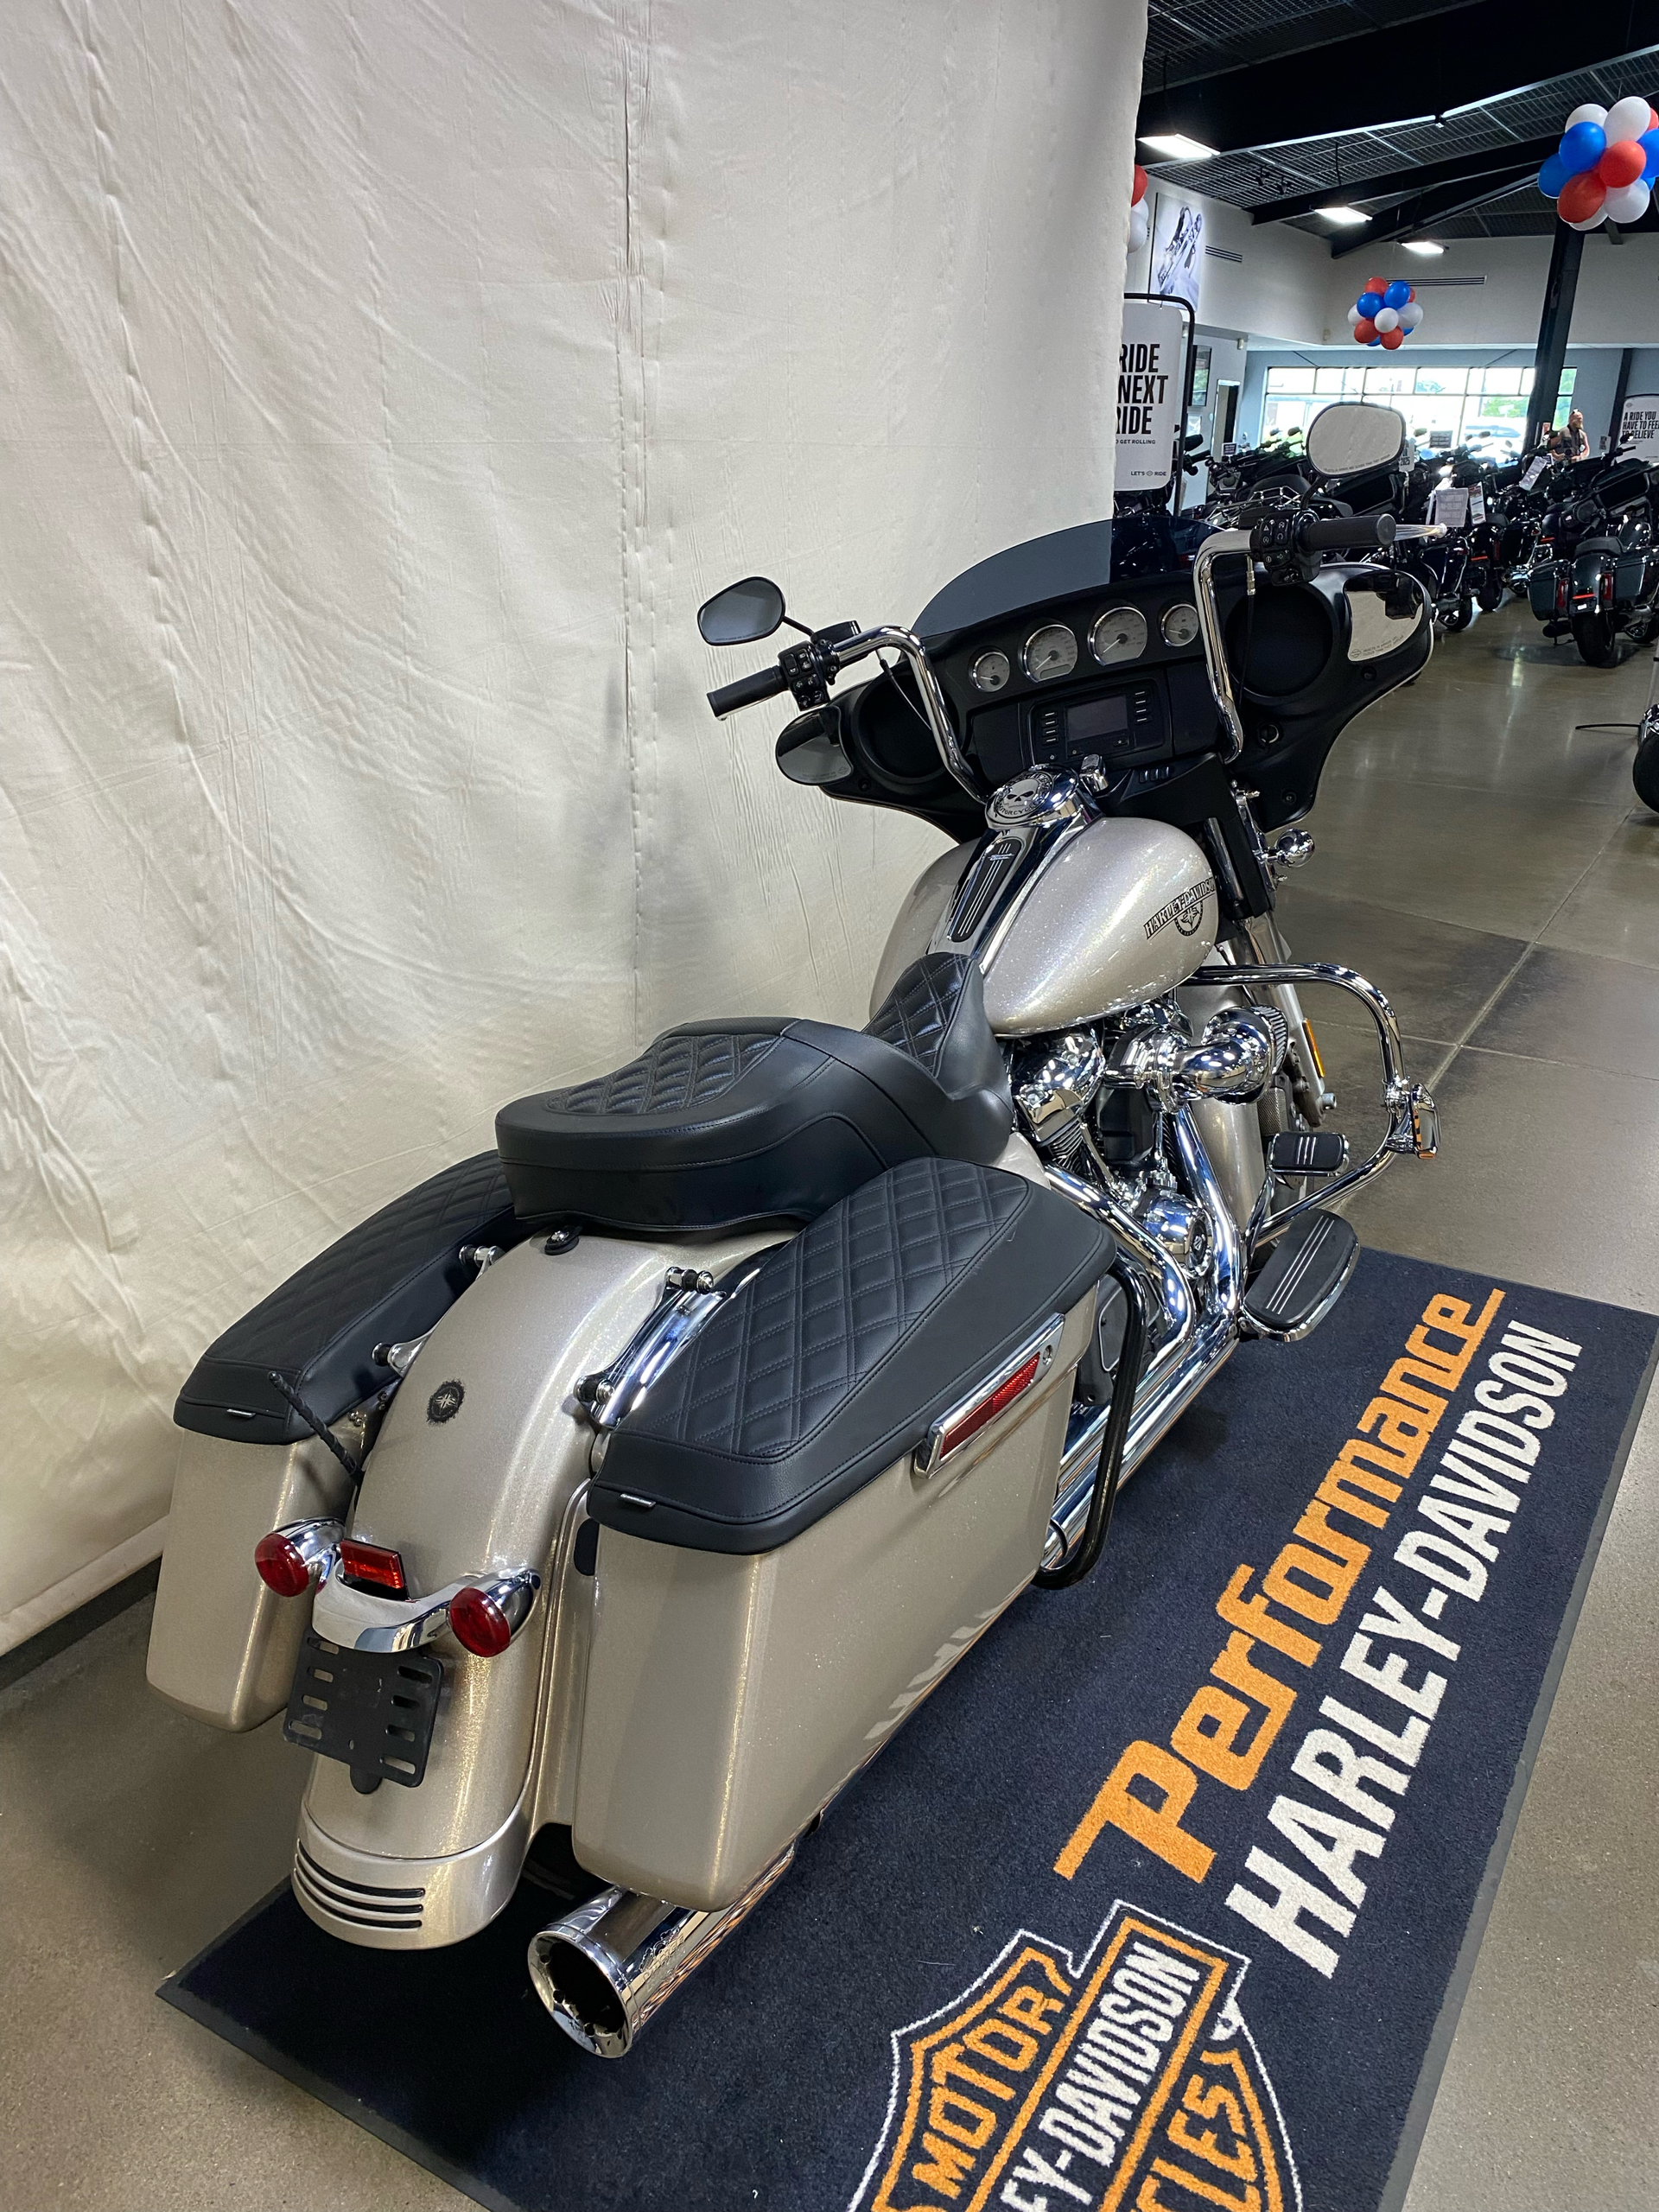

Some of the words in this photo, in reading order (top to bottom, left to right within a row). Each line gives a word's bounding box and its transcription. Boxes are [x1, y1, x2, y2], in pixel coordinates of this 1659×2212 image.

[1117, 375, 1169, 404] NEXT
[1623, 421, 1638, 430] HAVE
[1639, 421, 1648, 430] TO
[1648, 421, 1659, 430] FEE
[1624, 411, 1629, 421] A
[1629, 411, 1644, 421] RIDE
[1644, 411, 1657, 421] YOU
[1054, 1288, 1506, 1883] Performance
[1224, 1319, 1583, 1980] HARLEY-DAVIDSON
[912, 1986, 1065, 2199] MOTOR
